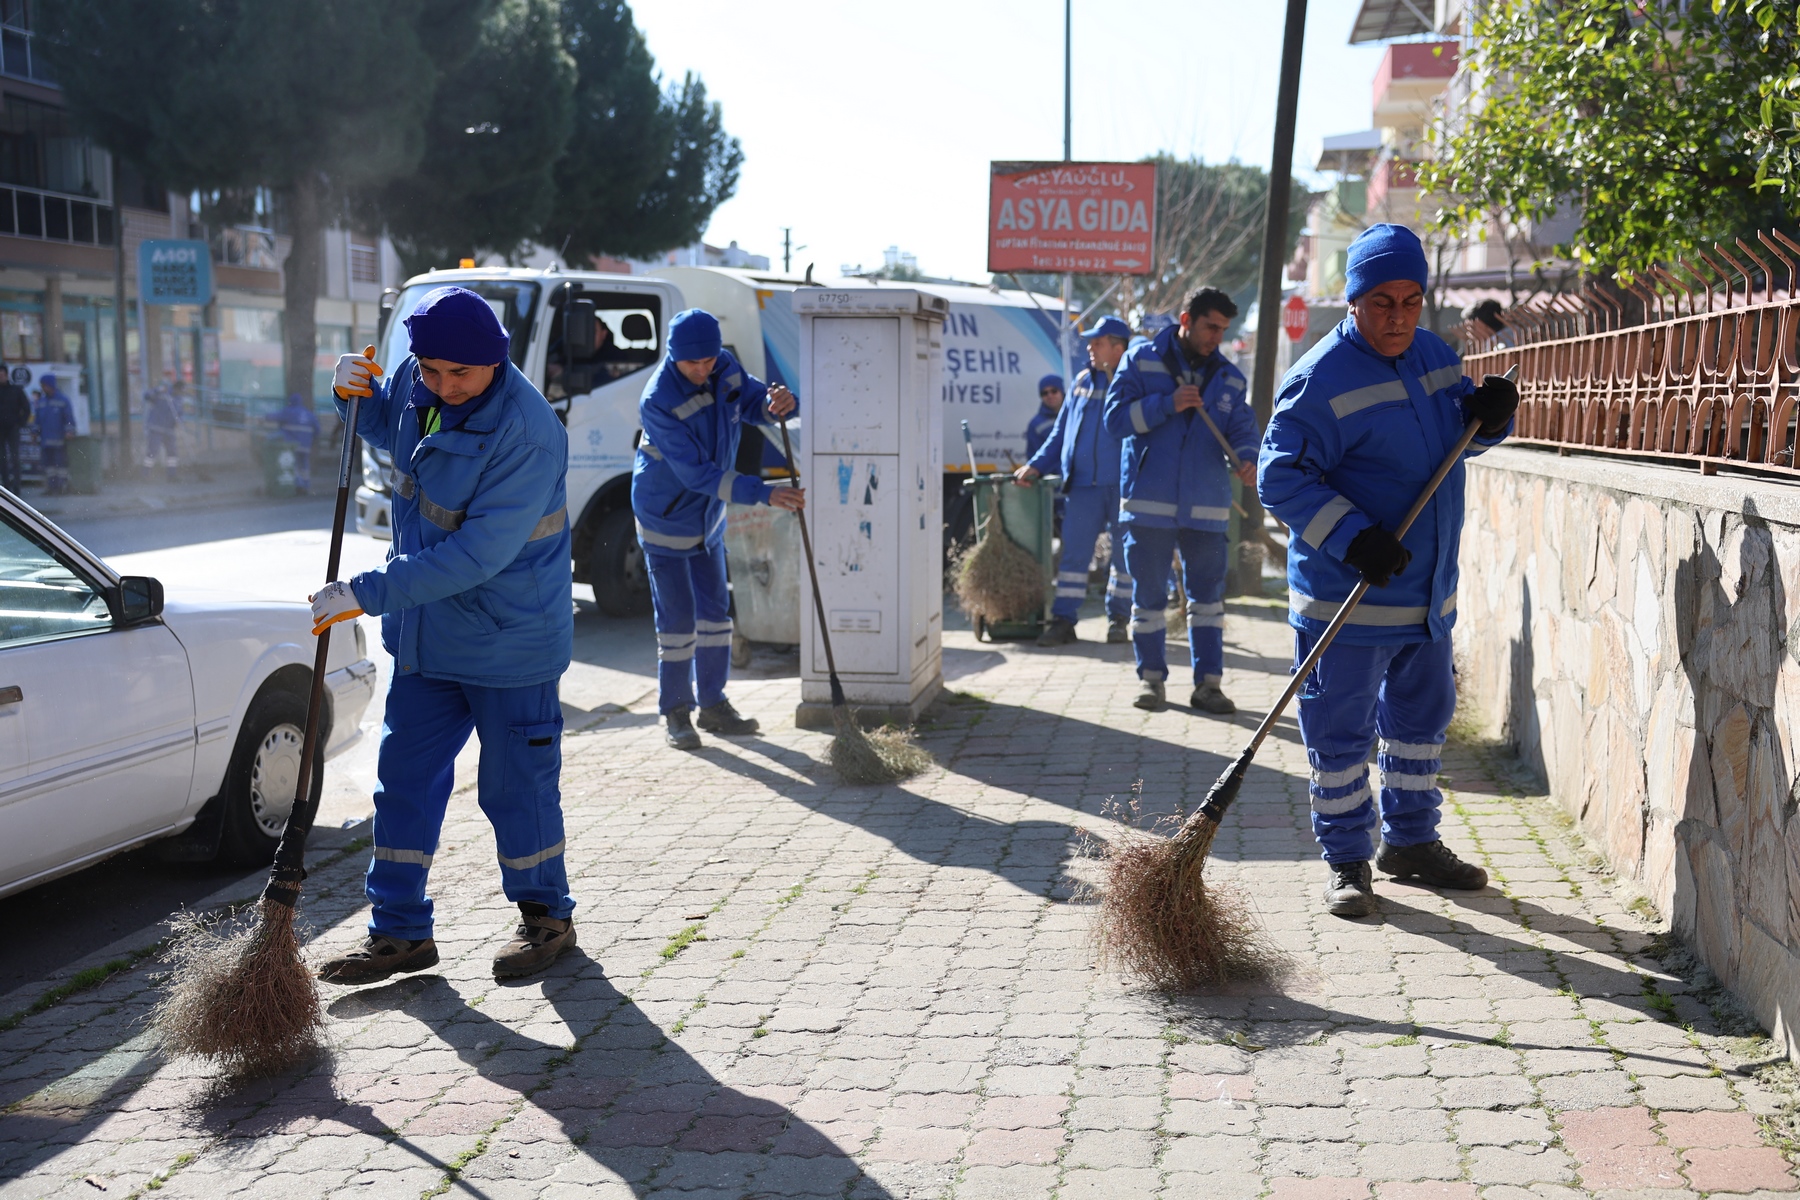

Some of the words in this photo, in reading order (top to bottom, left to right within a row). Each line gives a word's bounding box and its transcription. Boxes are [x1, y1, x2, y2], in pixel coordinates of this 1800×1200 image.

[997, 198, 1074, 231] ASYA
[1078, 198, 1149, 232] GIDA
[943, 345, 1022, 379] ŞEHİR
